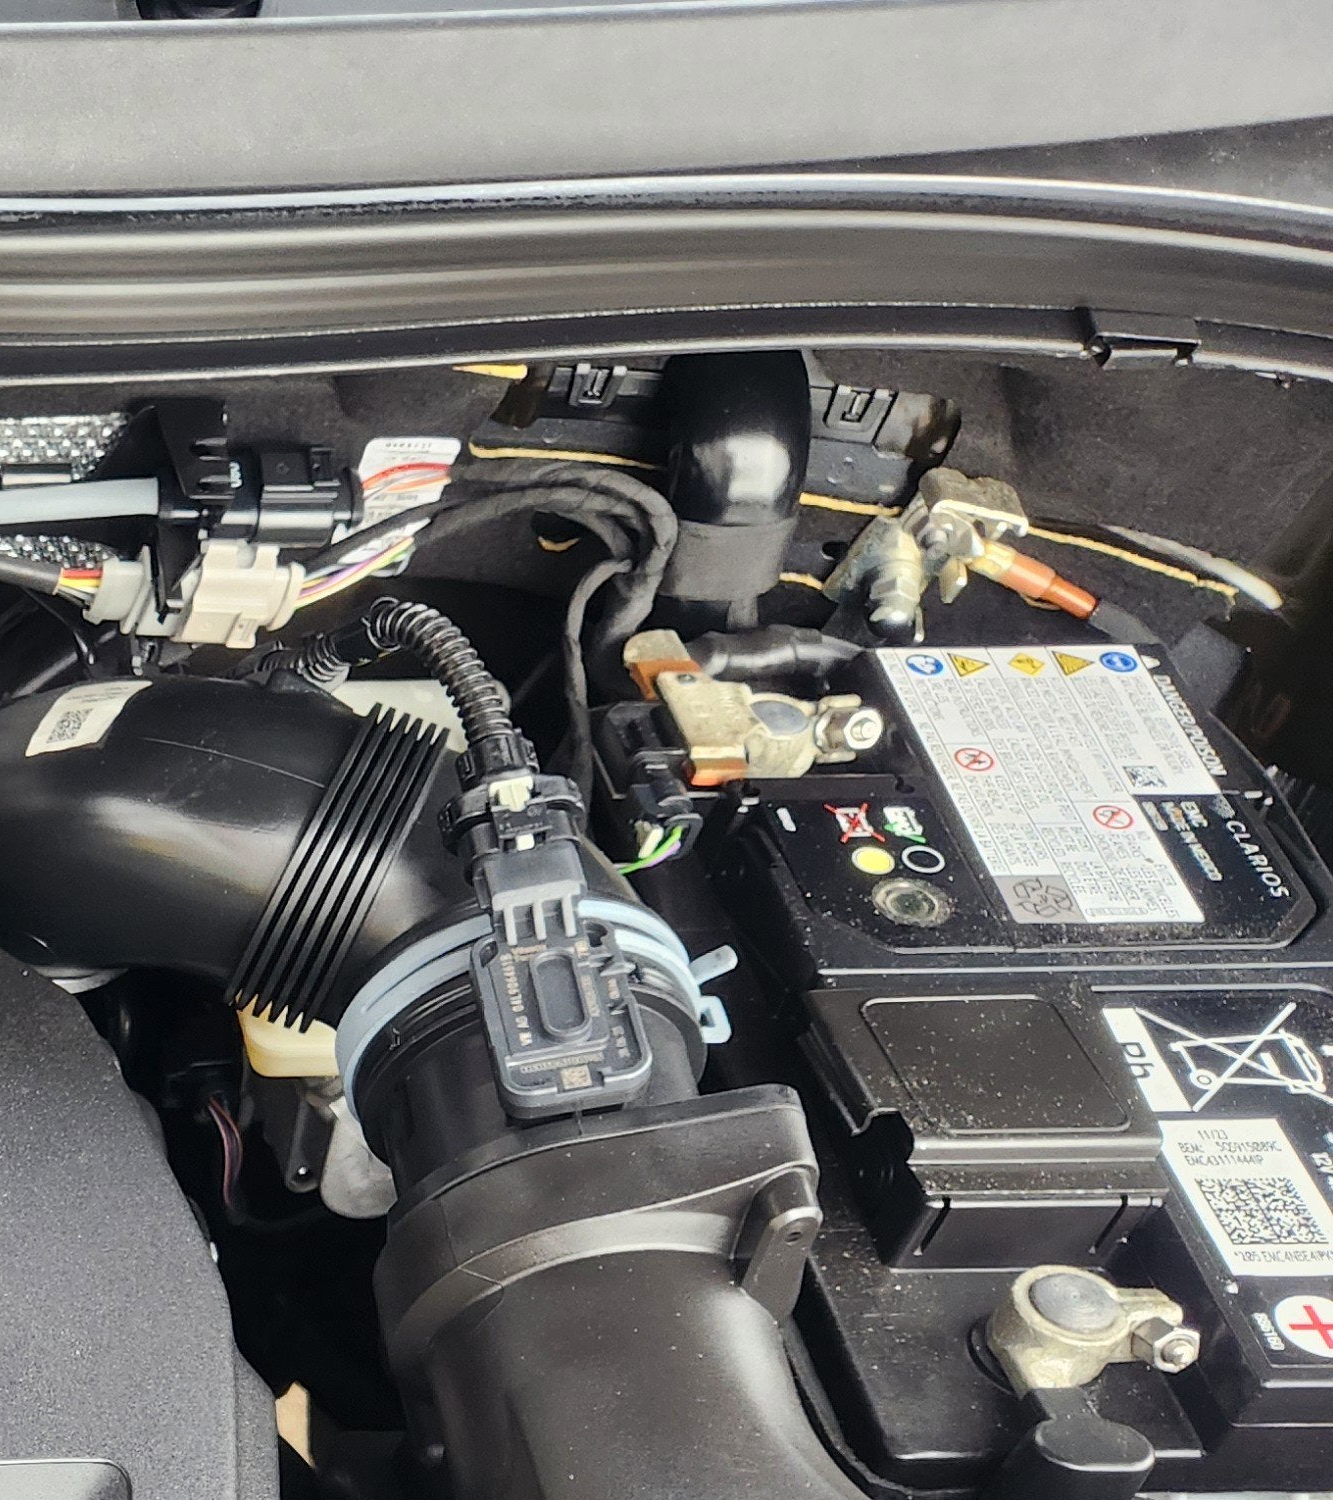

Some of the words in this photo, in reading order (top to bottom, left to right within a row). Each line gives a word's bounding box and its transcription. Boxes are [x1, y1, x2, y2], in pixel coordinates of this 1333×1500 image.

[1151, 675, 1226, 774] DANGER/POISON
[1222, 821, 1291, 896] CLARIOS
[1196, 1128, 1229, 1141] 11/23
